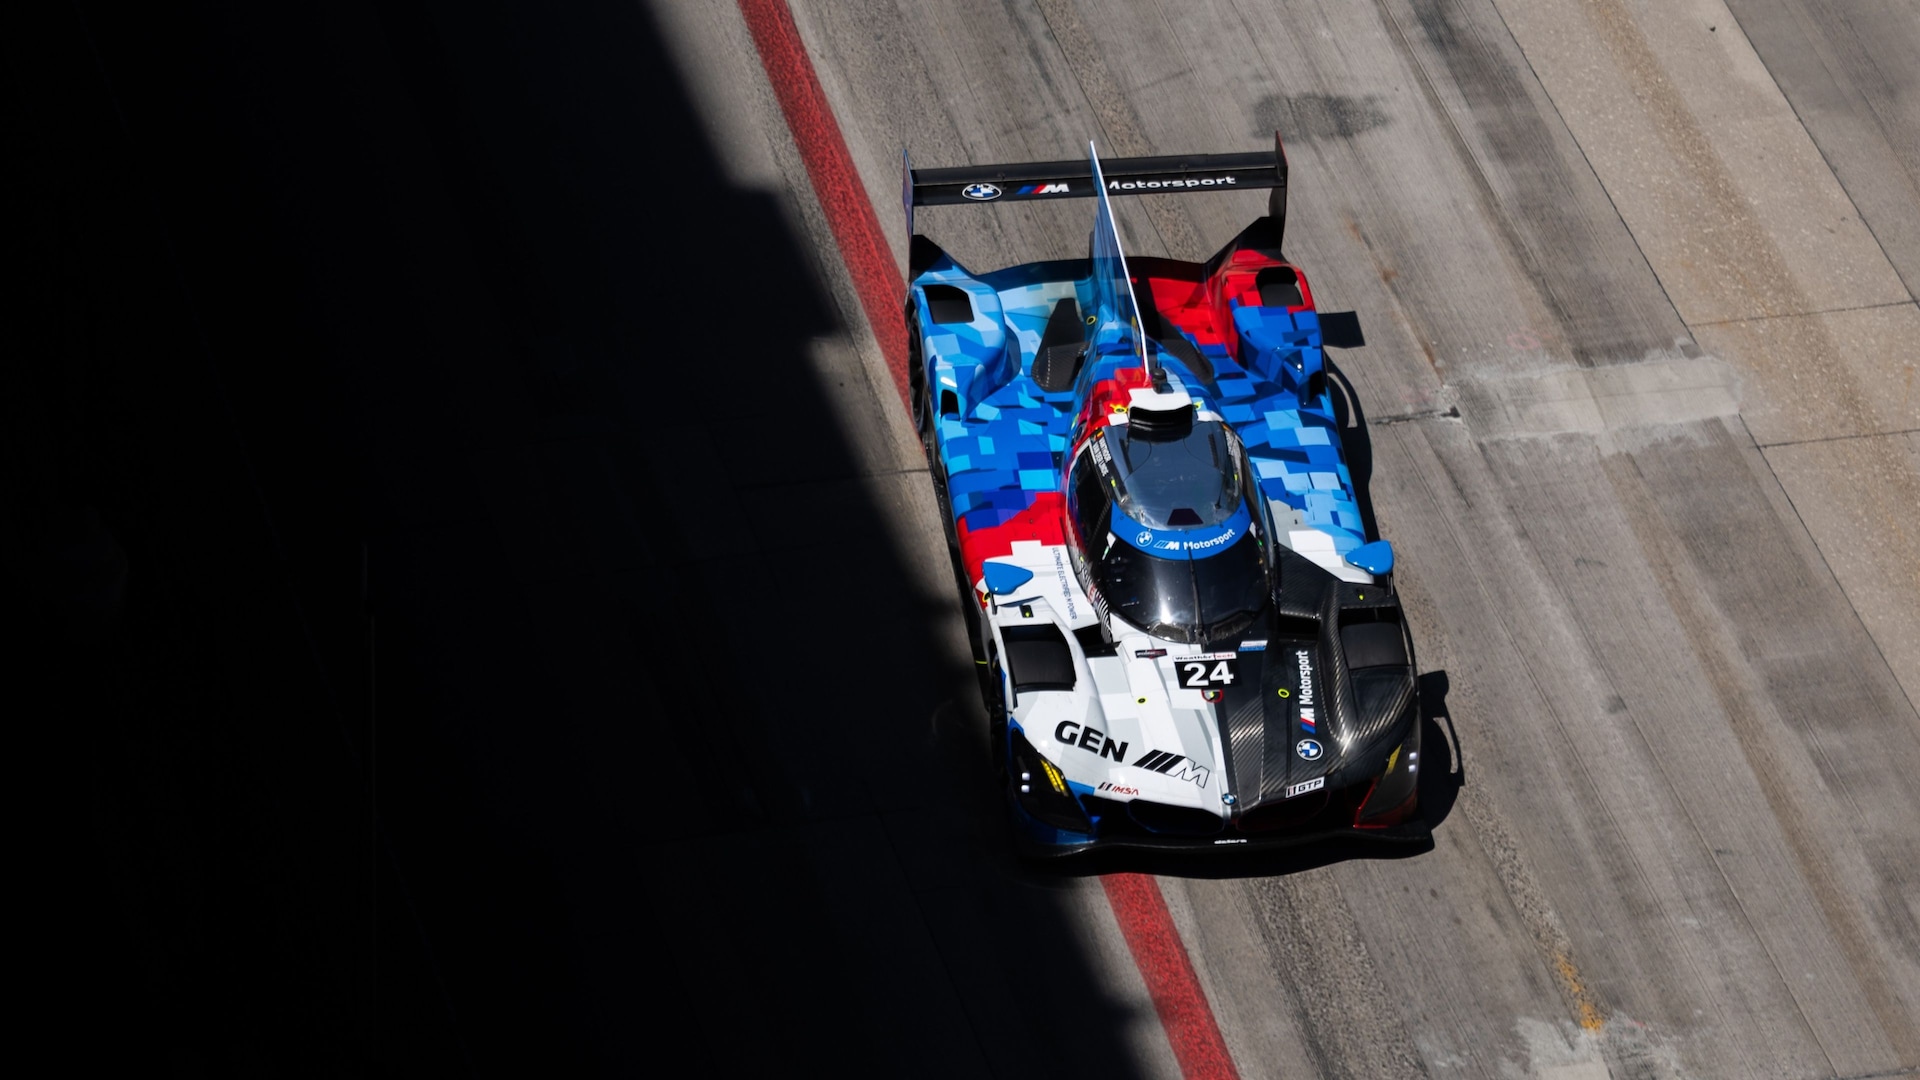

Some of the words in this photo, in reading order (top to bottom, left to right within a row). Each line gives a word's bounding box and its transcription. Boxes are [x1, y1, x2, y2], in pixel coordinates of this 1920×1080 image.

[1183, 528, 1235, 550] Motorsport
[1184, 661, 1234, 686] 24
[1295, 650, 1313, 705] Motorsport
[1055, 720, 1129, 763] GEN
[1112, 785, 1139, 796] IMSA
[1298, 780, 1322, 791] GTP
